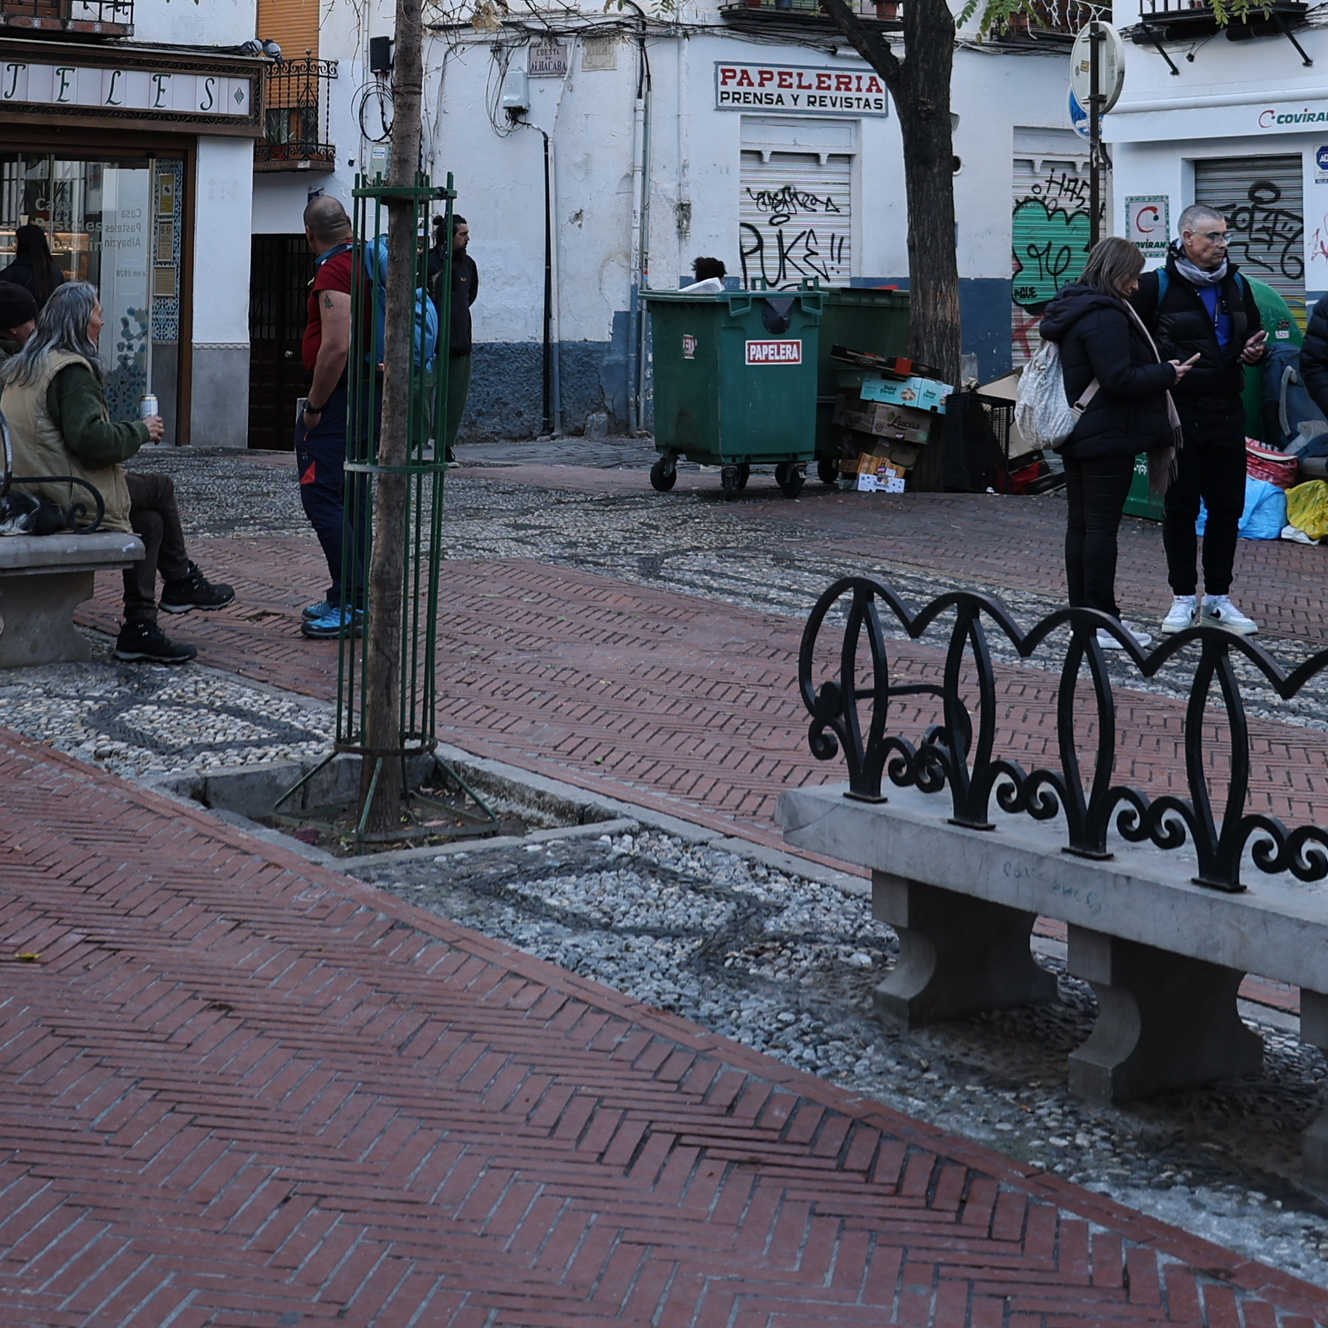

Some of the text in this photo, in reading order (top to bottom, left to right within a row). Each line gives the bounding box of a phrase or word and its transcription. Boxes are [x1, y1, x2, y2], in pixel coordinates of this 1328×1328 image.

[720, 68, 884, 93] PAPELERIA
[720, 91, 883, 110] PRENSA Y REVISTAS
[749, 343, 799, 361] PAPELERA
